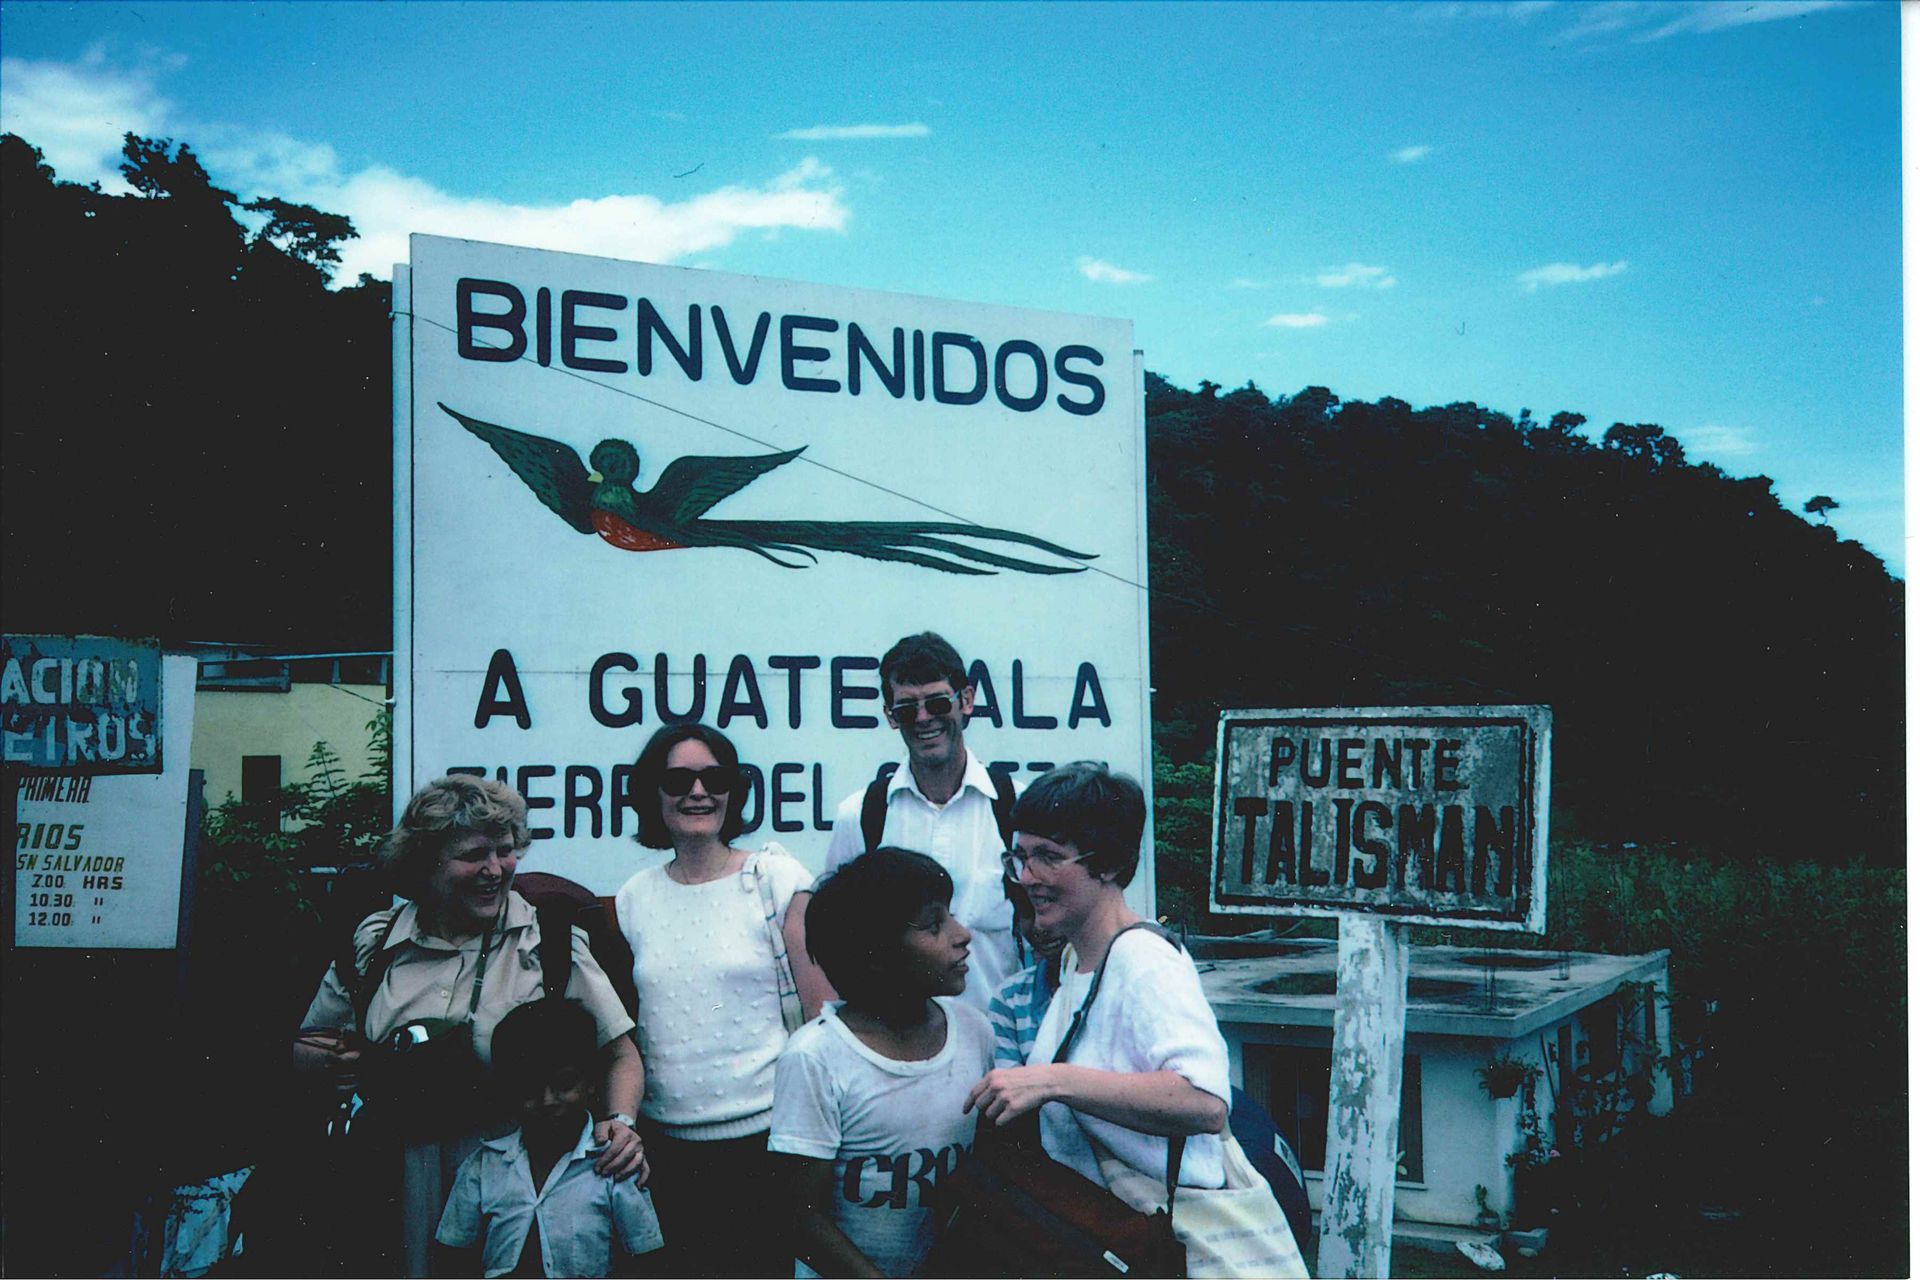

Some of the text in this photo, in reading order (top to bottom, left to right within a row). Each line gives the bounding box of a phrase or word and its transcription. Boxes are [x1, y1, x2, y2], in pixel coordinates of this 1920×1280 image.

[456, 278, 1106, 416] BIENVENIDOS
[475, 648, 1112, 730] A GUATEALA
[1268, 736, 1470, 792] PUENTE
[42, 855, 126, 872] SALVADOR
[1233, 797, 1515, 898] TALISMAN
